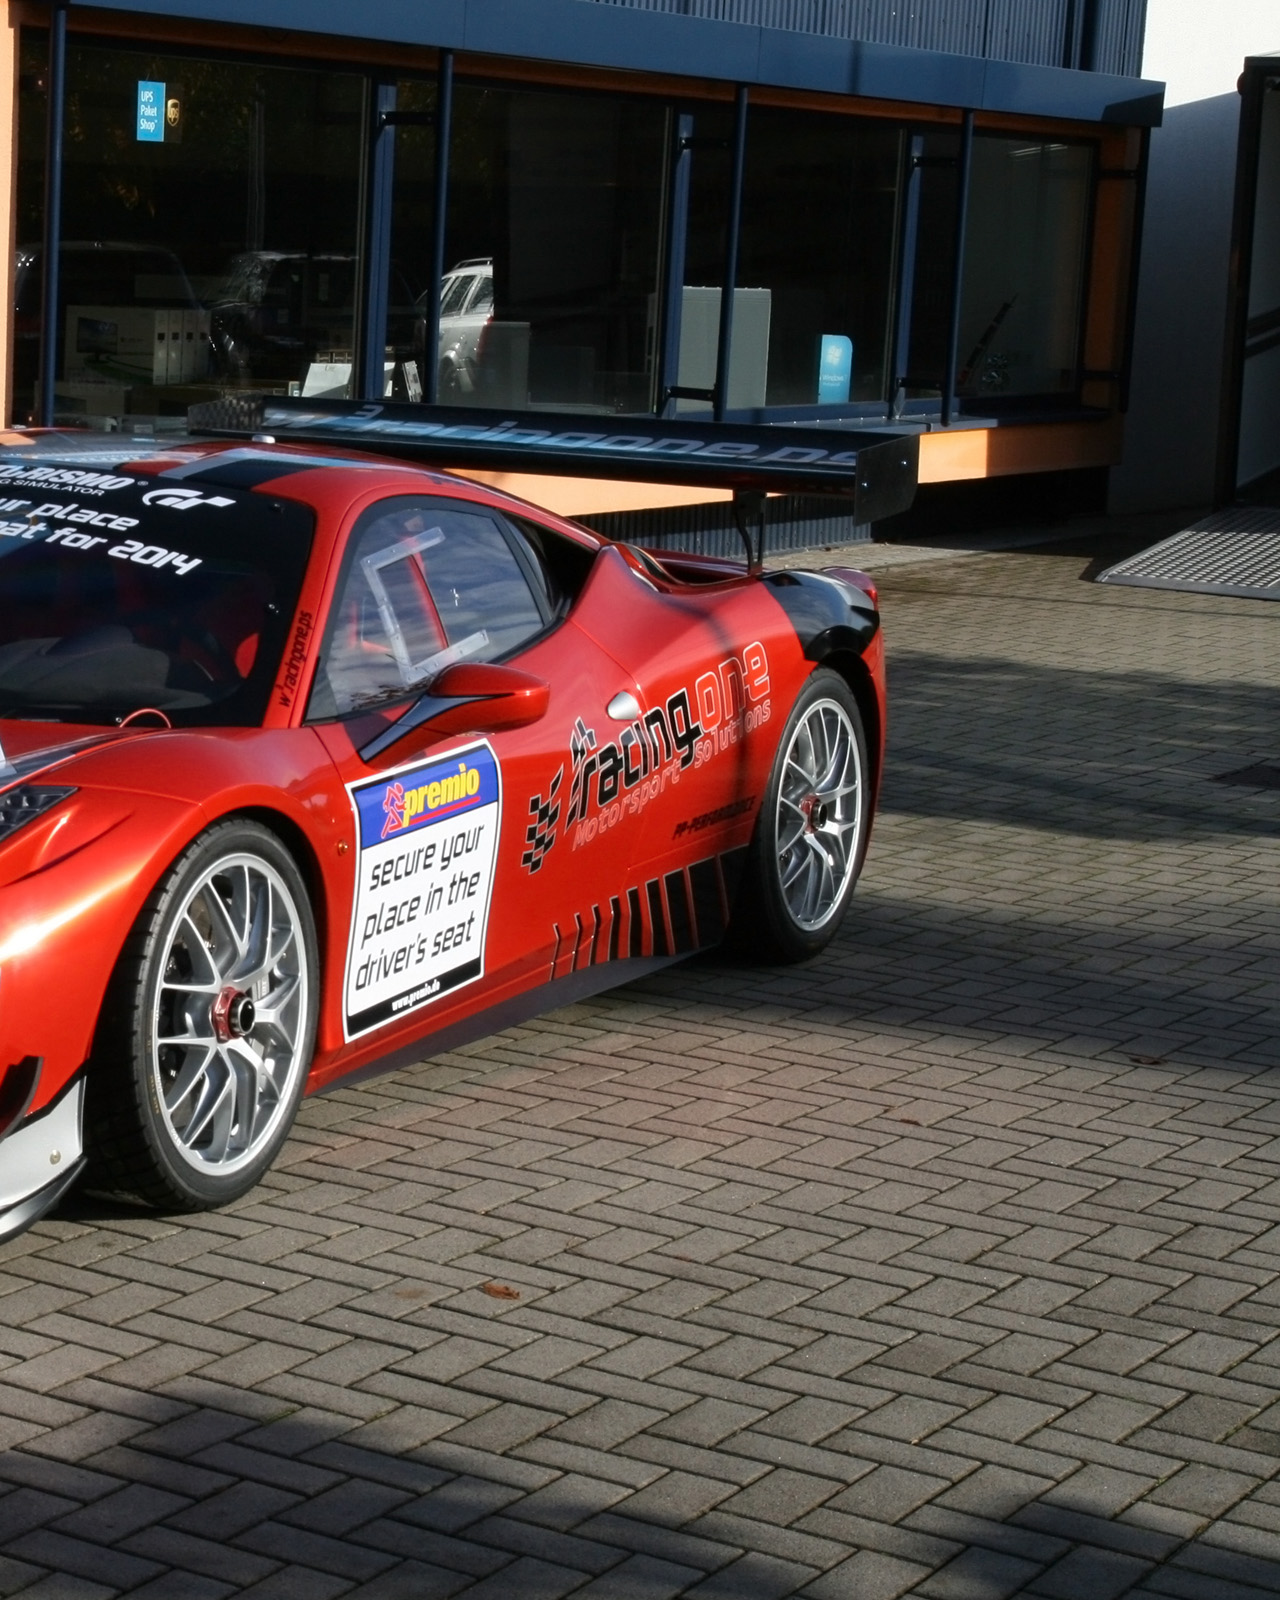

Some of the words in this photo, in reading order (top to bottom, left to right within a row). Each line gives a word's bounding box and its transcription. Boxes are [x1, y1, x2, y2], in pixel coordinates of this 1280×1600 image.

[140, 90, 153, 102] UPS
[140, 104, 157, 116] Paket
[140, 118, 156, 133] Shop
[12, 479, 105, 497] SIMULATOR
[25, 502, 140, 531] place
[45, 527, 108, 550] for
[107, 539, 203, 575] 2014
[402, 763, 480, 828] premio
[572, 758, 681, 852] Motorsport
[693, 699, 771, 769] solutions
[369, 842, 436, 892] secure
[440, 824, 485, 872] your
[361, 895, 421, 950] place
[424, 882, 444, 916] in
[447, 870, 481, 906] the
[355, 932, 428, 991] driver's
[431, 910, 475, 958] seat
[392, 978, 441, 1012] www.premio.de
